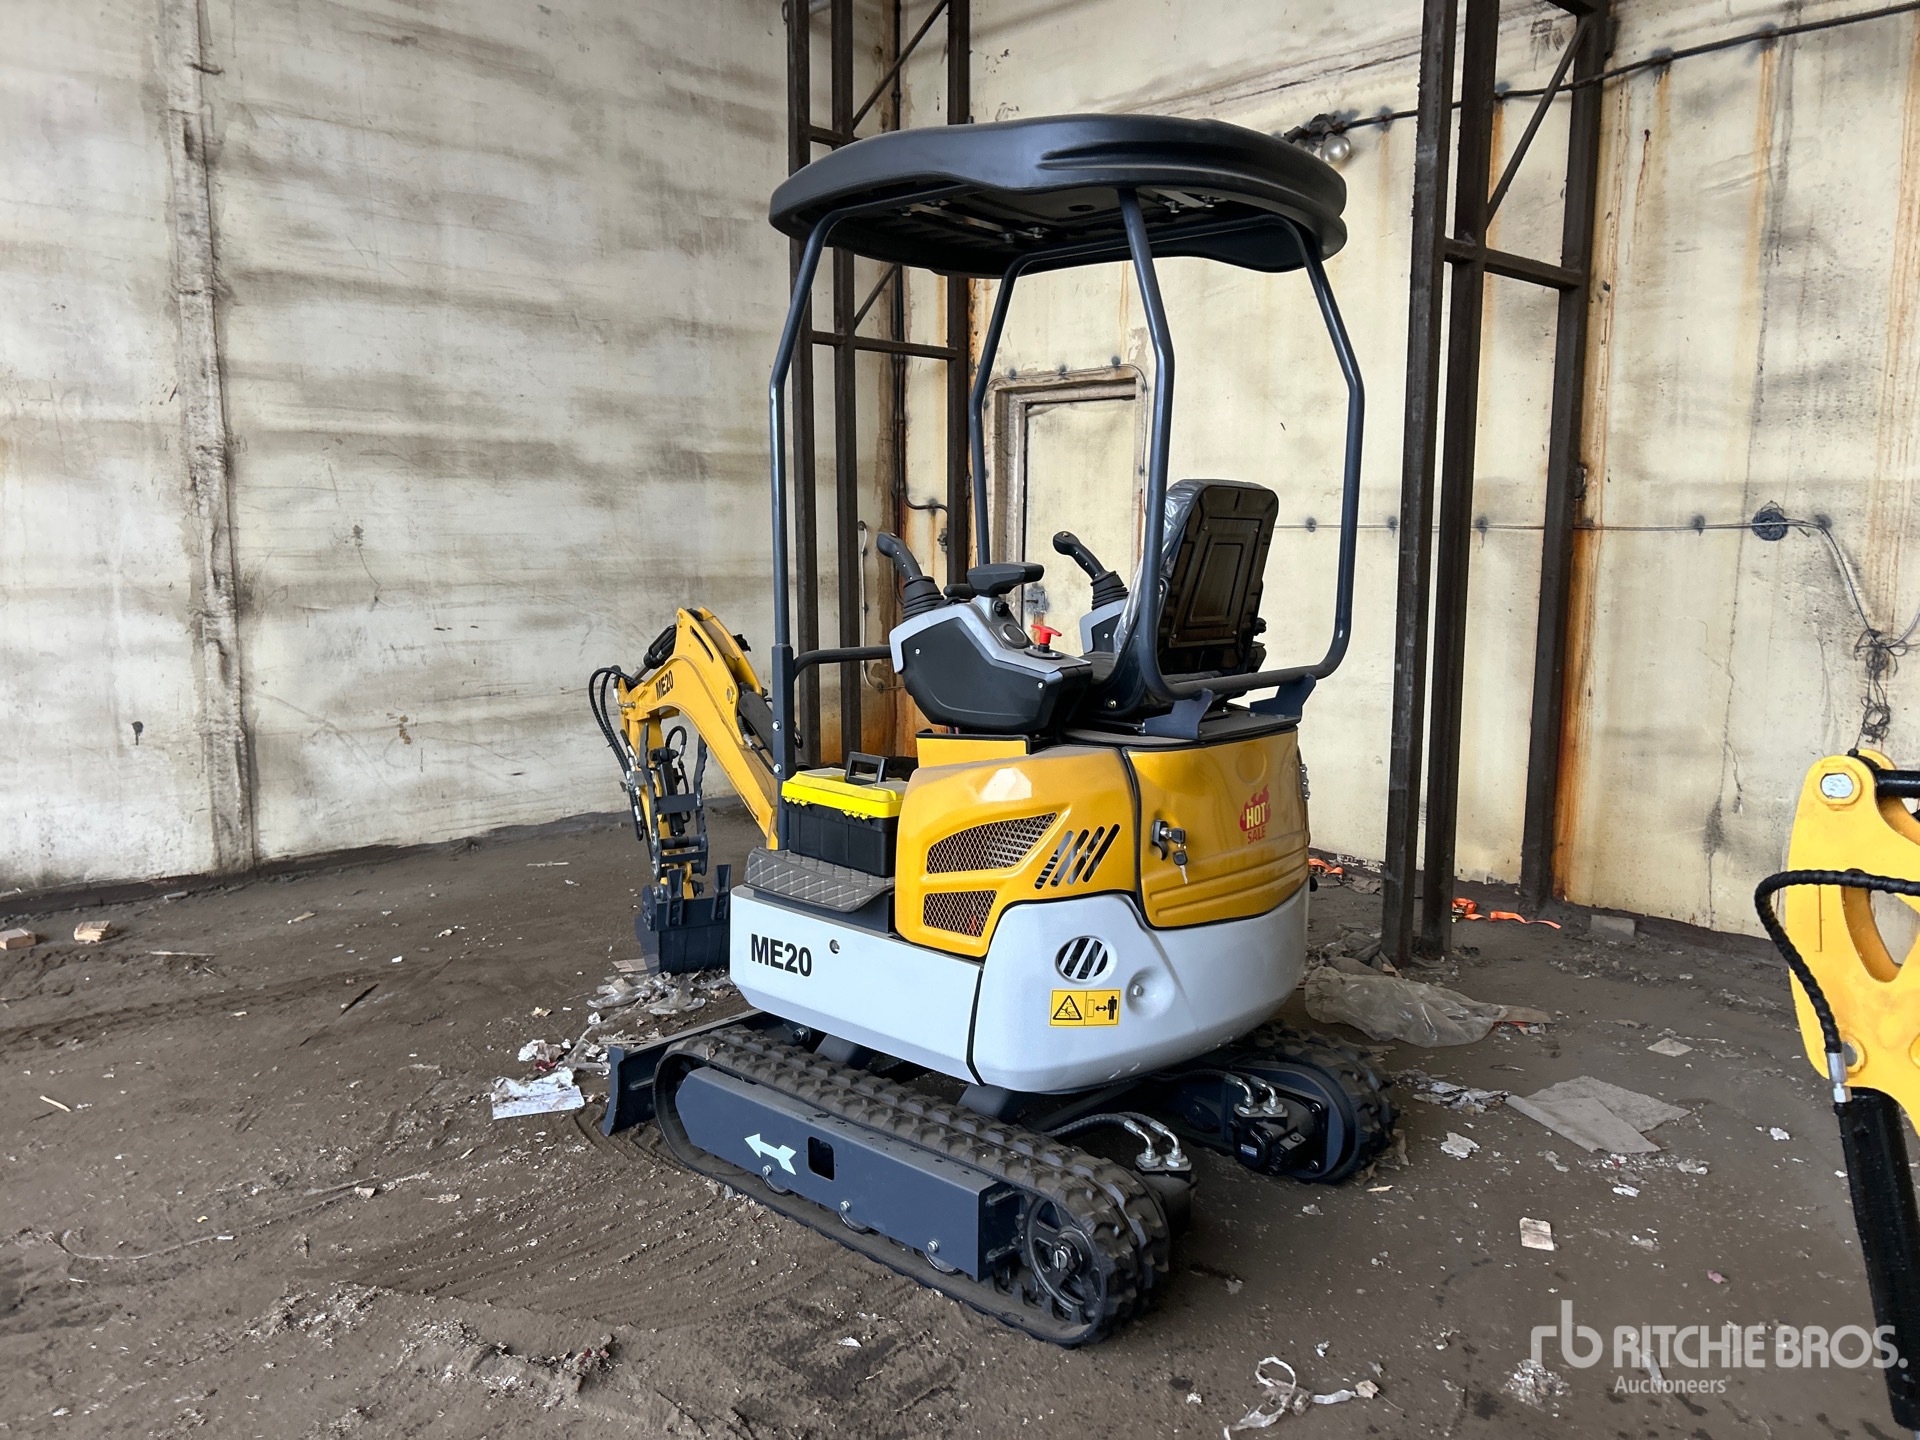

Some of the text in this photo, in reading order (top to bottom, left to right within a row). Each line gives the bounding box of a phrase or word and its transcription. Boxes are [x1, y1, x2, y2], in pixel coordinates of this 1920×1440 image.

[655, 669, 674, 701] ME20
[1246, 802, 1266, 829] HOT
[1247, 825, 1265, 844] SALE
[751, 933, 812, 977] ME20
